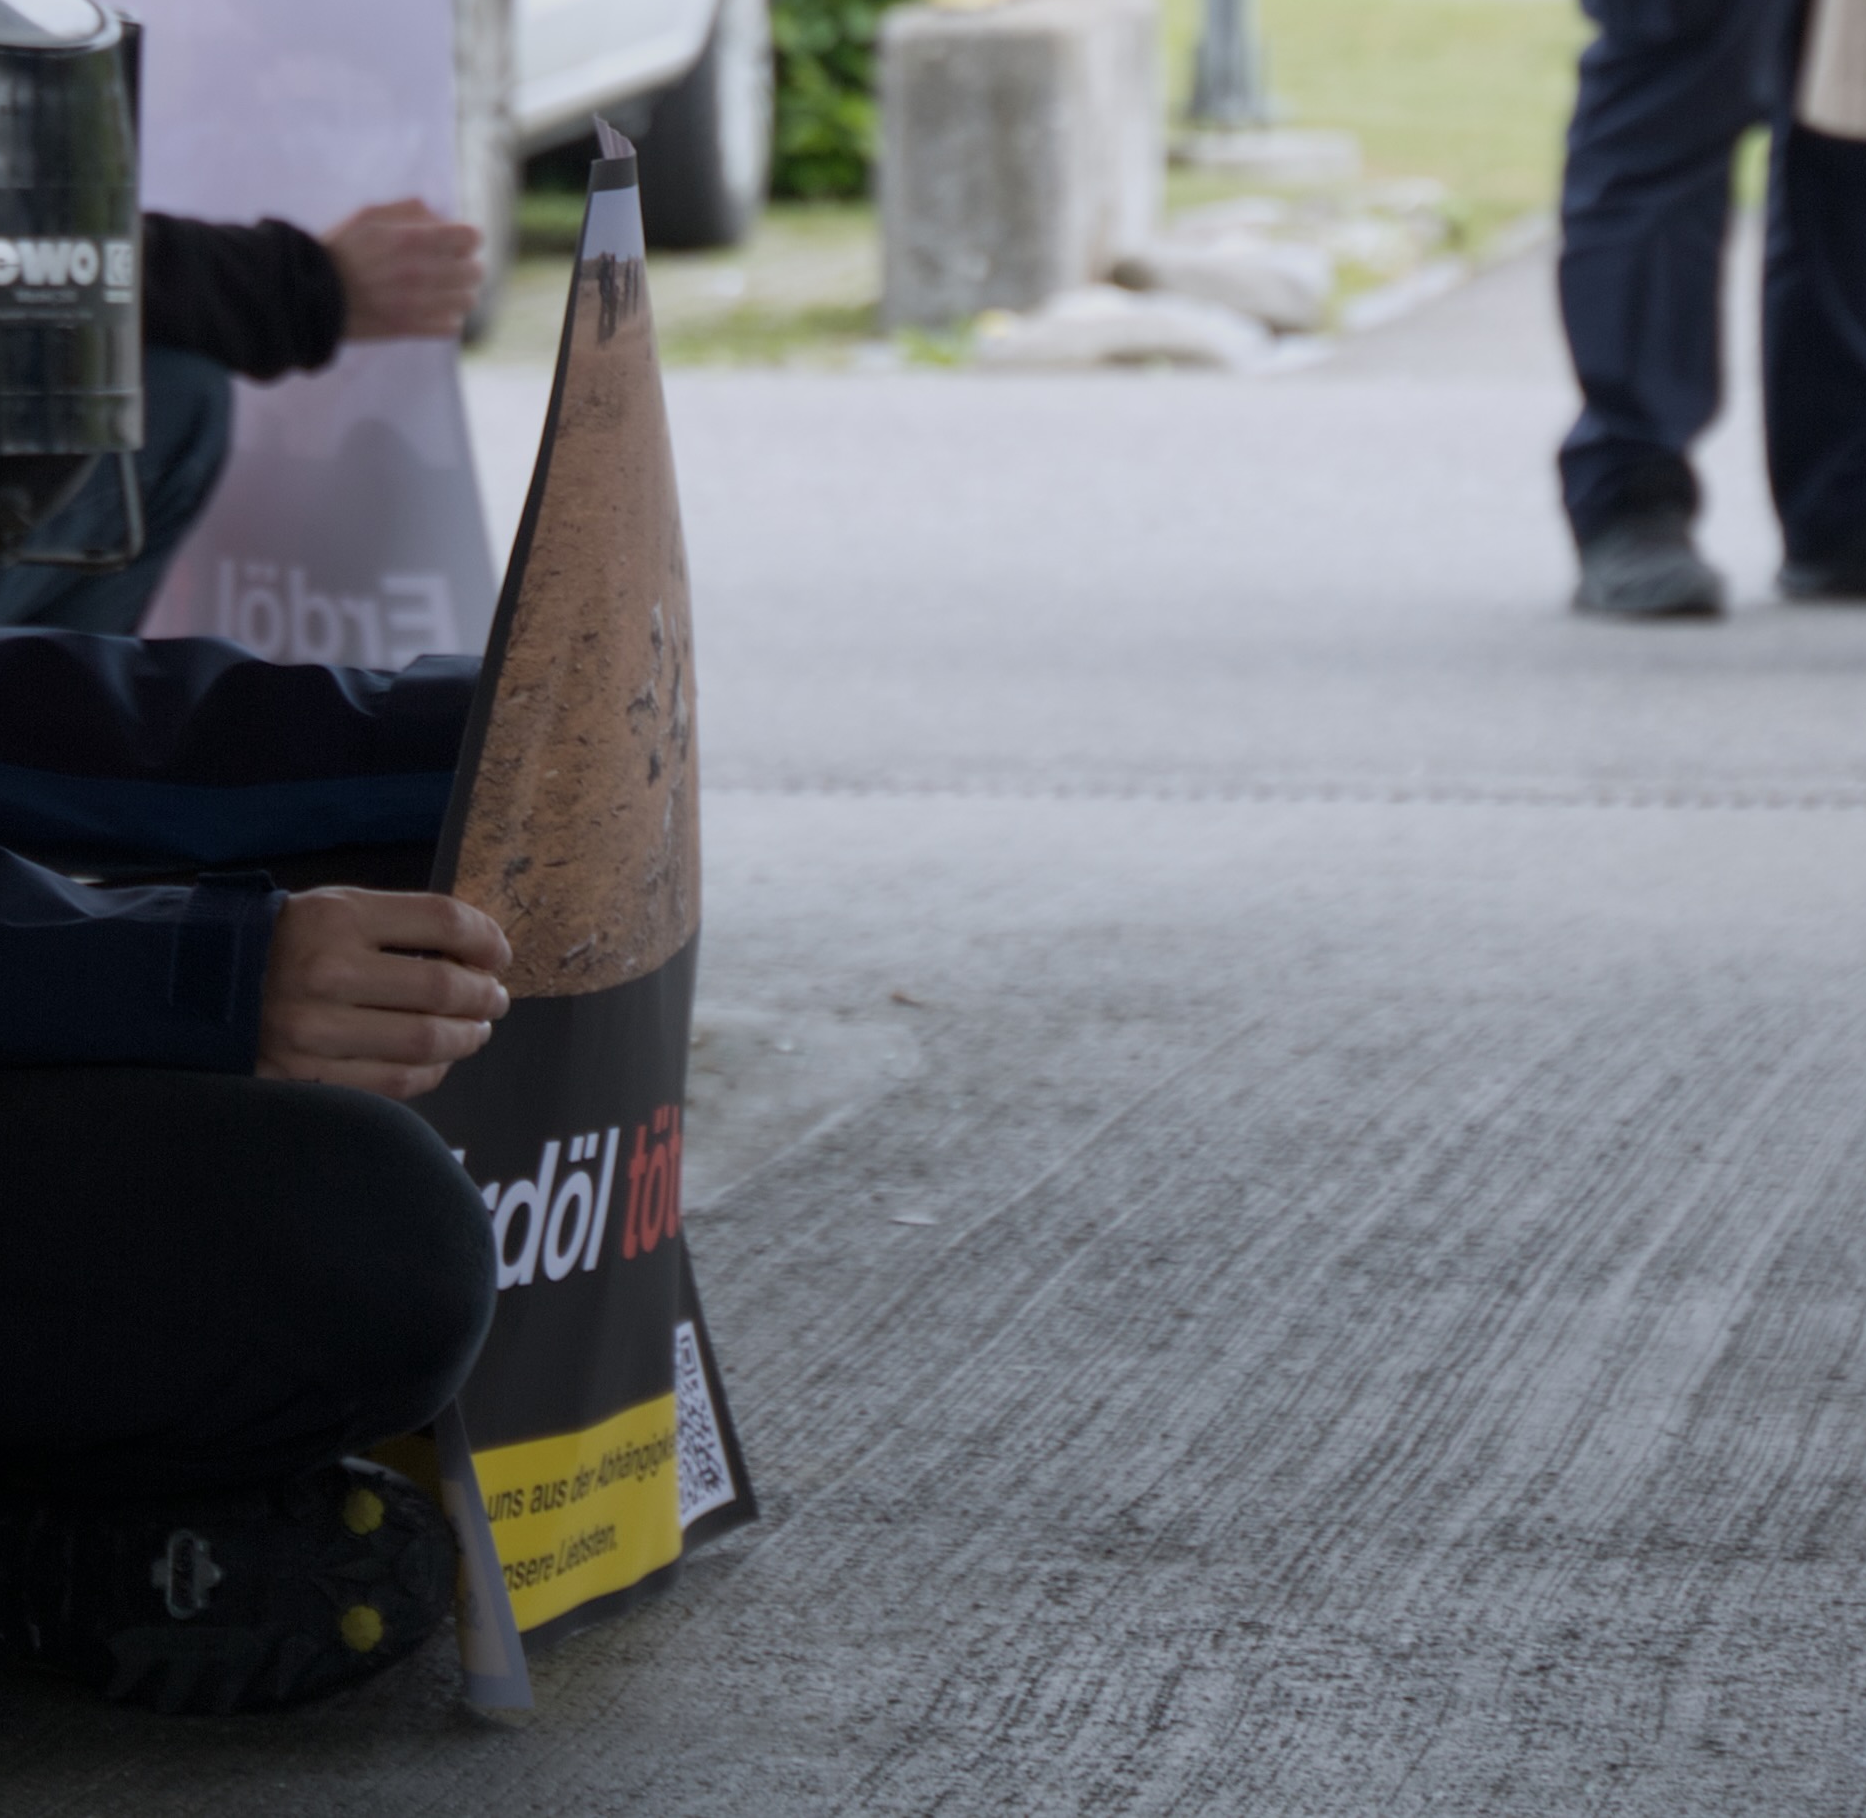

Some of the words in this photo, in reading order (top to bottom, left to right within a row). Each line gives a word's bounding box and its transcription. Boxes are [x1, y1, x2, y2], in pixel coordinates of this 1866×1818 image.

[451, 1127, 621, 1291] döl
[487, 1488, 525, 1523] uns
[530, 1479, 568, 1514] aus
[570, 1466, 595, 1503] der
[503, 1553, 555, 1591] nsere
